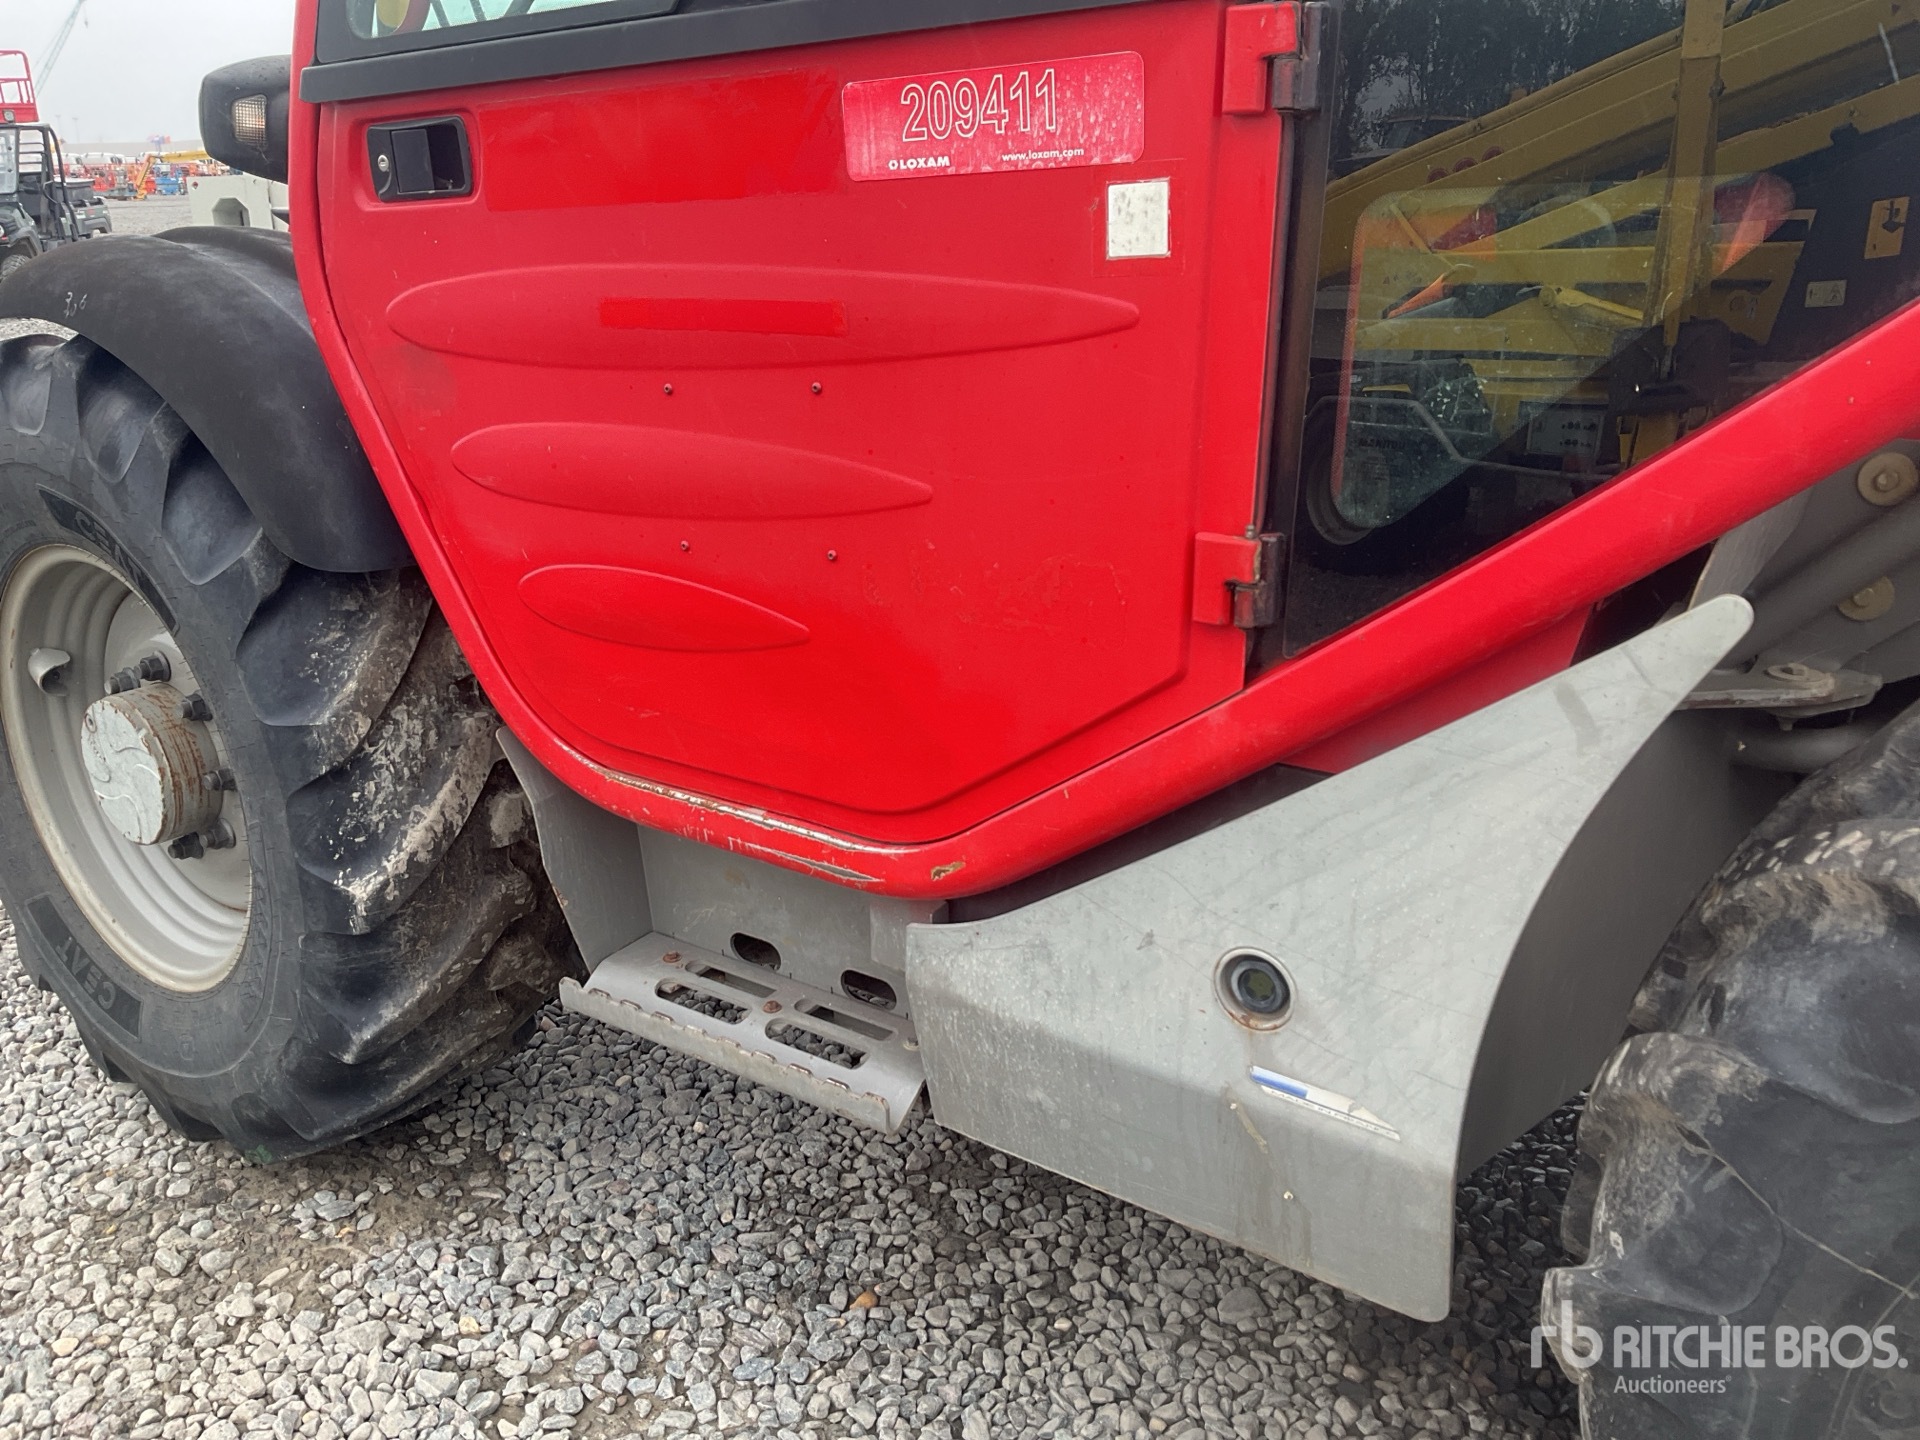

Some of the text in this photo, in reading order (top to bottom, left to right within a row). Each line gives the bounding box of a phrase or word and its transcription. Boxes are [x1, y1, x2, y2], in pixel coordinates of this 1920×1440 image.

[900, 67, 1057, 142] 209411
[1002, 148, 1084, 161] www.loxam.com
[899, 155, 950, 170] LOXAM
